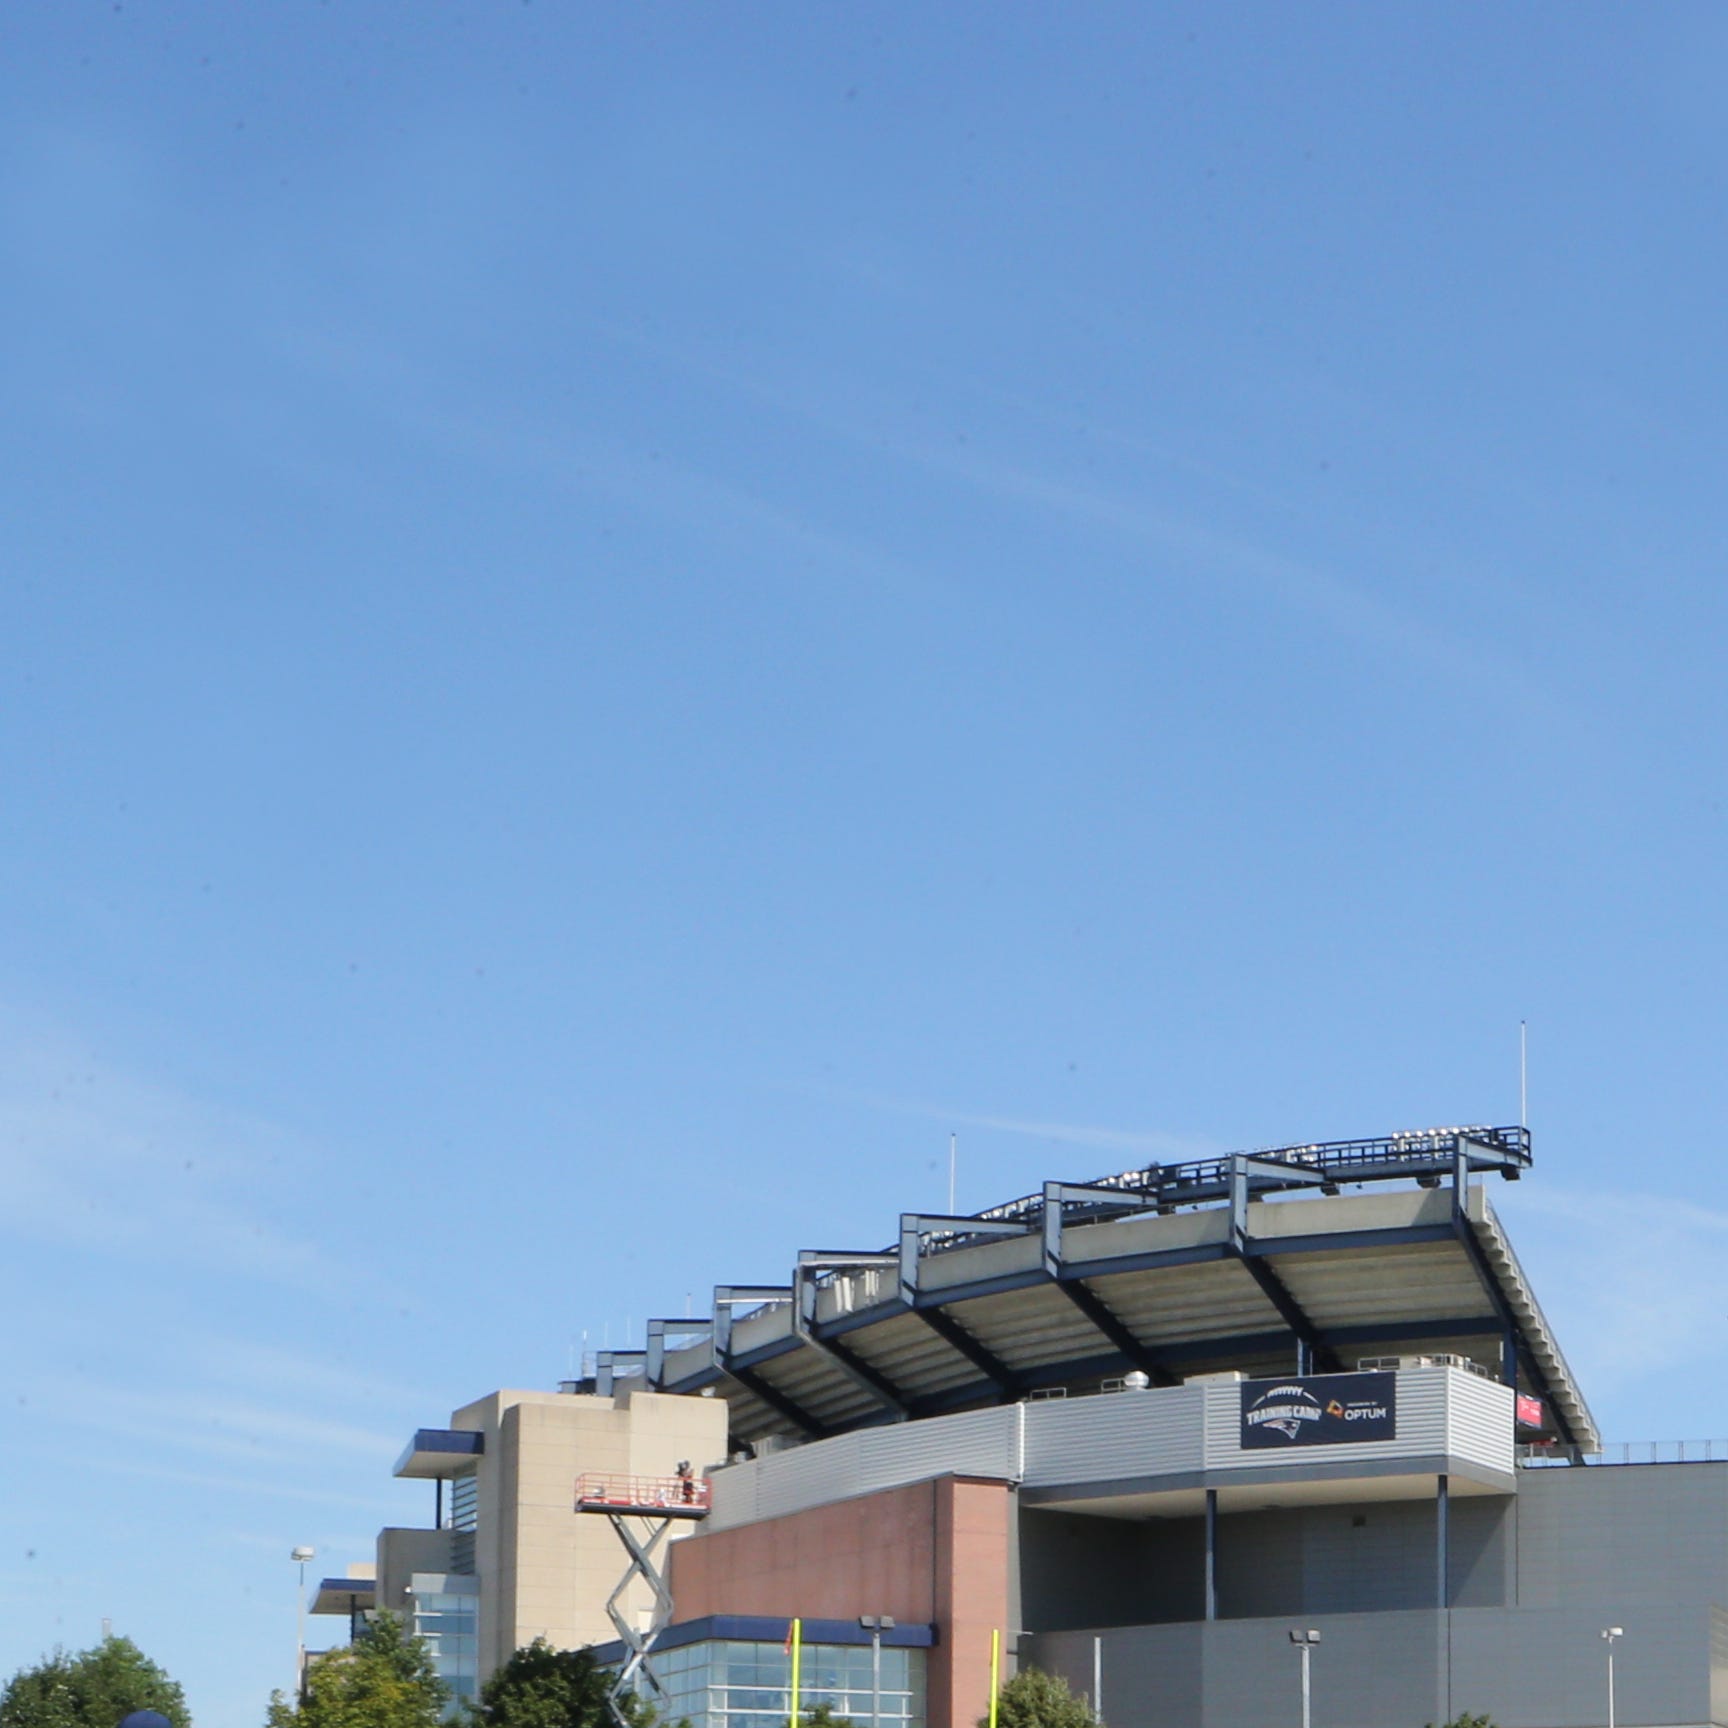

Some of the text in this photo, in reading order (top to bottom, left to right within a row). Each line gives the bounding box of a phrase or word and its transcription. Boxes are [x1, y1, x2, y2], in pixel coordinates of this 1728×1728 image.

[1246, 1405, 1322, 1426] TRAINING CAMP
[1344, 1408, 1387, 1421] OPTUM
